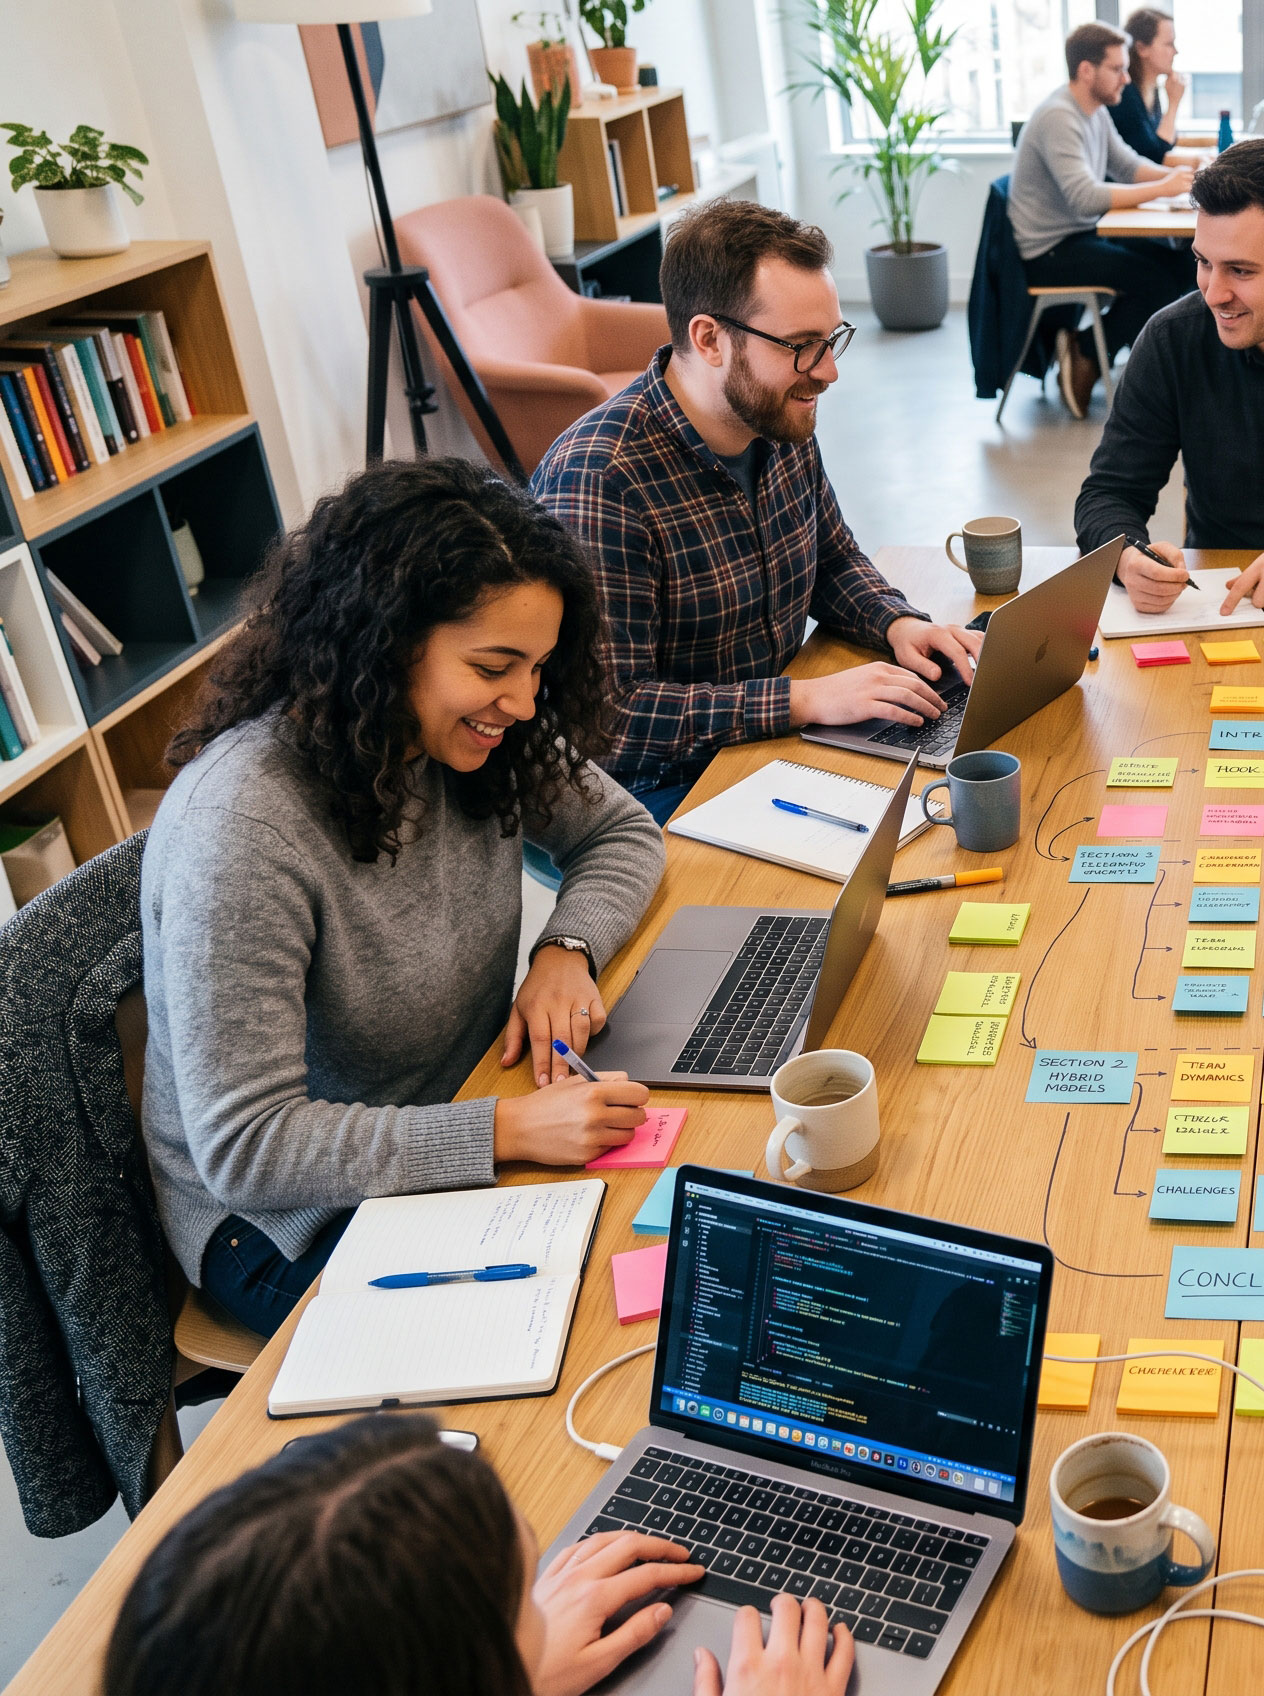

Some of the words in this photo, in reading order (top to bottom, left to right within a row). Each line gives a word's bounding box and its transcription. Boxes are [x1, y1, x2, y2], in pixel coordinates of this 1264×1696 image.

[1039, 1057, 1105, 1067] SECTION
[1110, 1059, 1129, 1069] 2
[1049, 1072, 1104, 1082] HYBRID
[1045, 1084, 1106, 1093] MODELS
[1157, 1185, 1236, 1195] CHALLENGES
